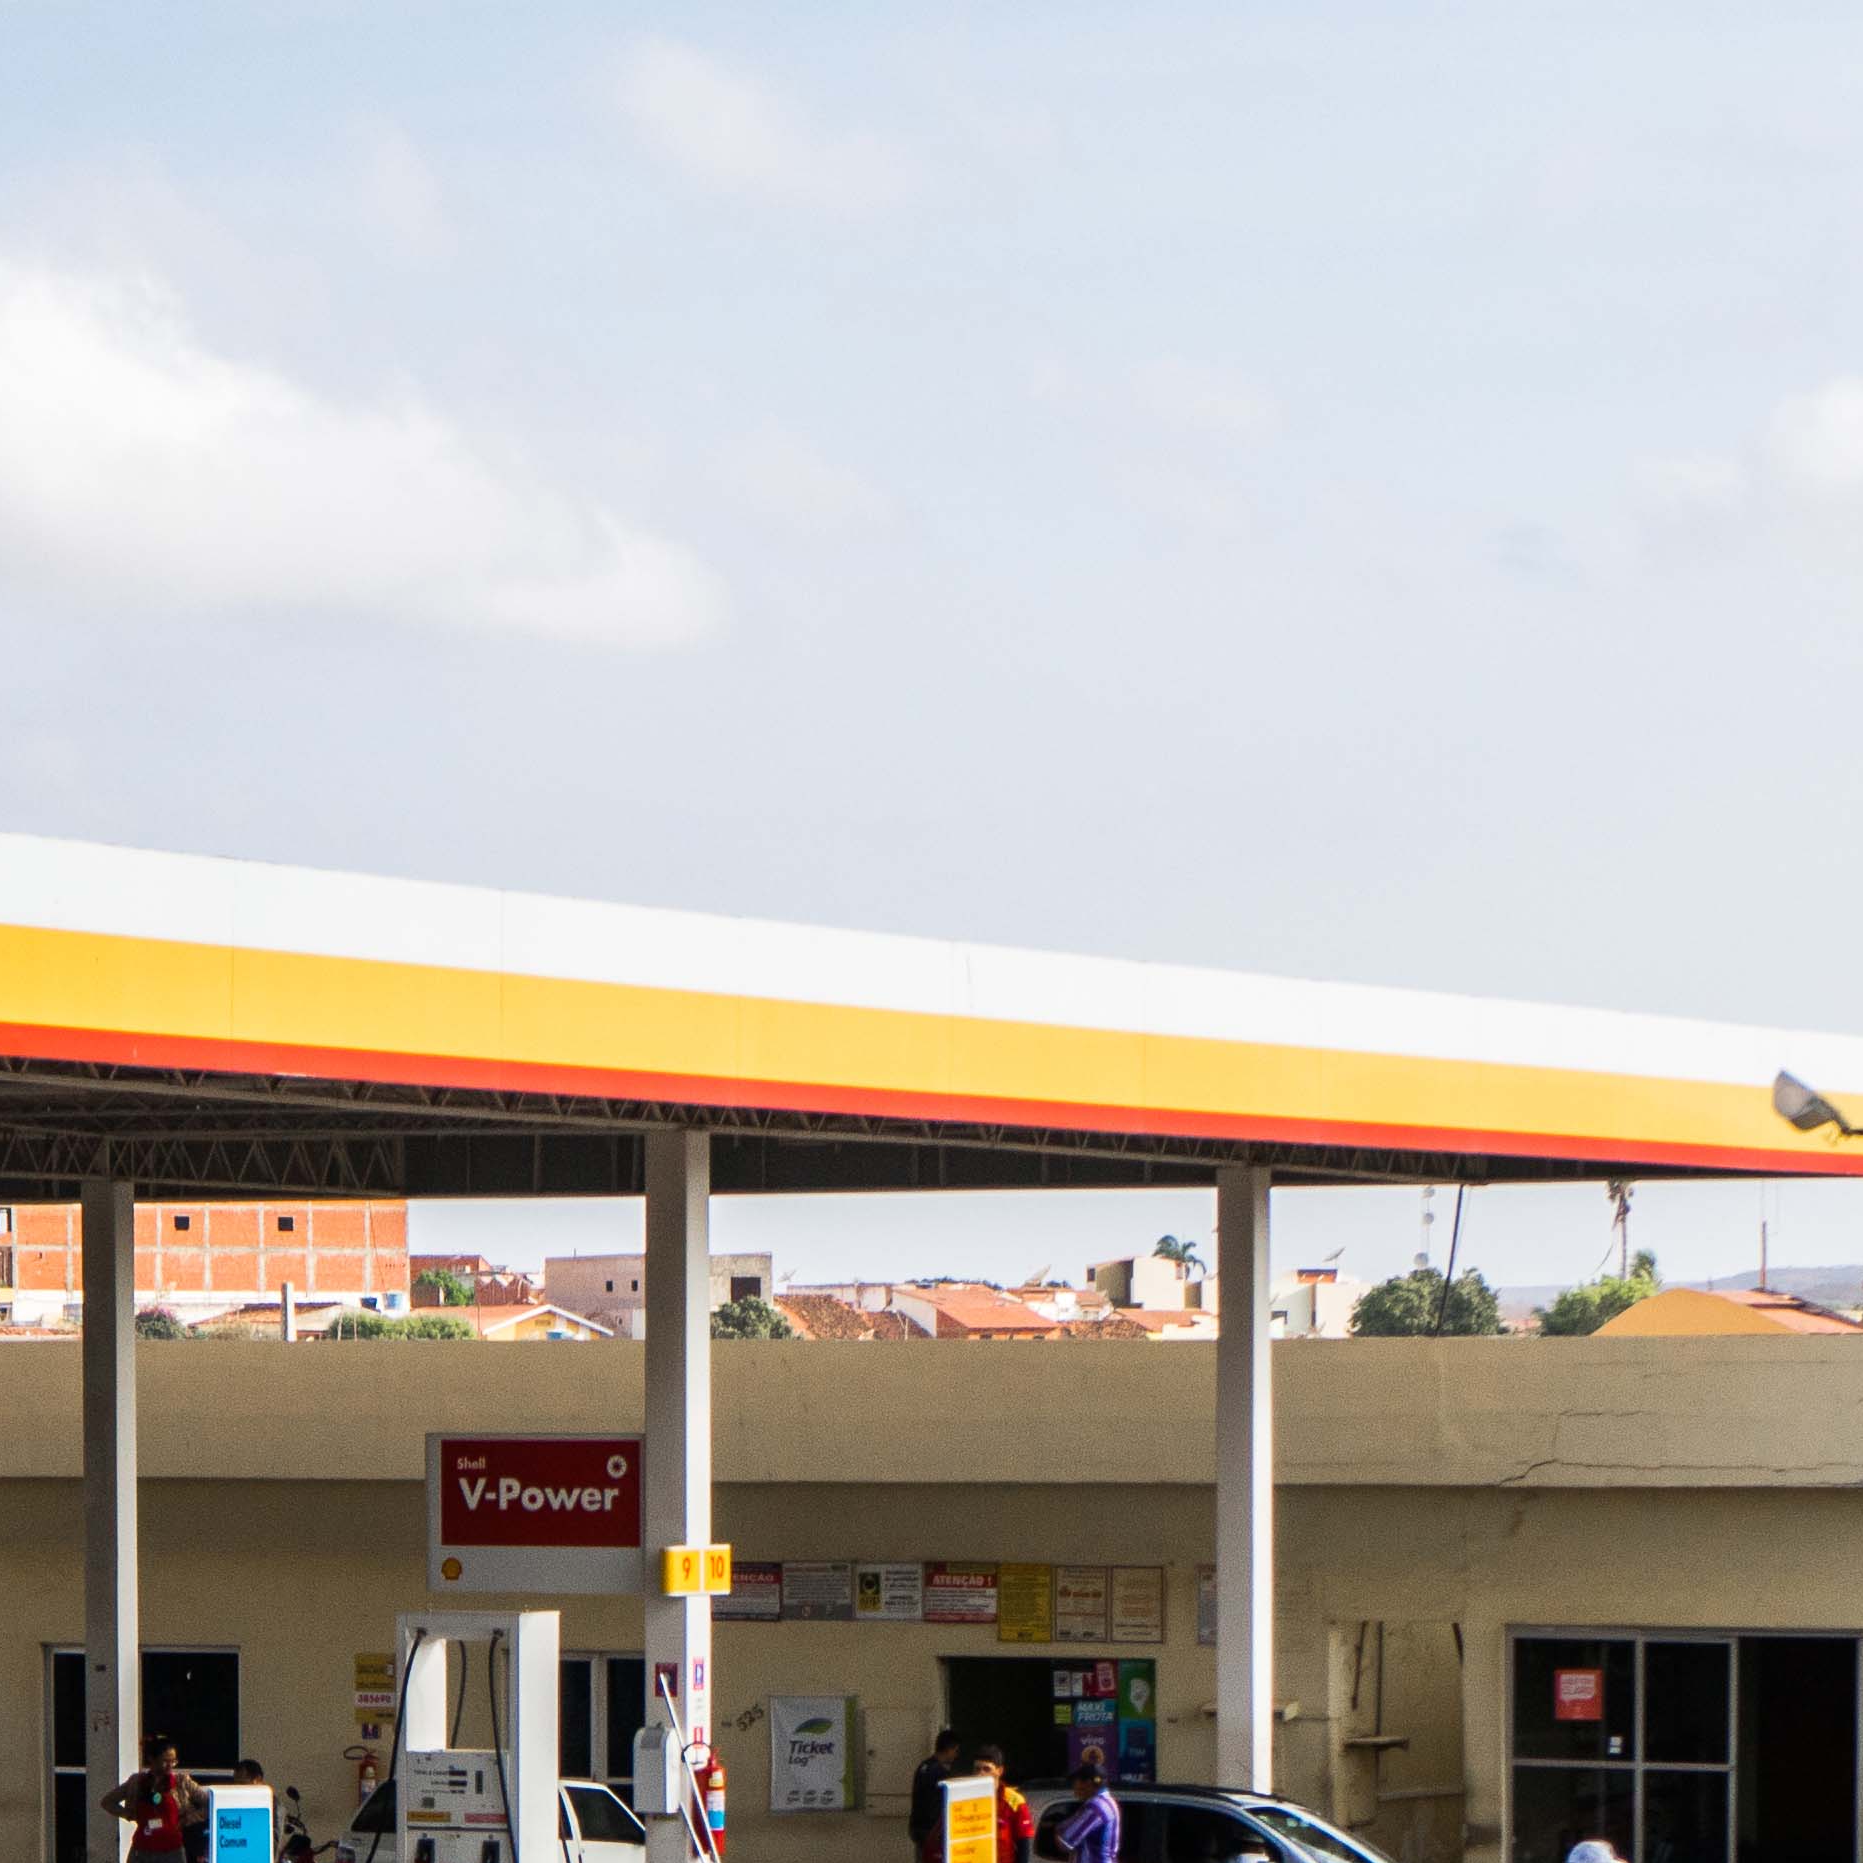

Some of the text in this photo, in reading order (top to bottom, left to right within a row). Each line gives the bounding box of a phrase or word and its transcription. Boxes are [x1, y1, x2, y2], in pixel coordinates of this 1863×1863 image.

[457, 1456, 486, 1470] Shell
[458, 1477, 620, 1512] V-Power
[681, 1555, 725, 1580] 9 10
[932, 1571, 985, 1587] ATENÇÃO
[789, 1740, 835, 1755] Ticket
[788, 1755, 810, 1767] Log
[219, 1816, 242, 1830] Diesel
